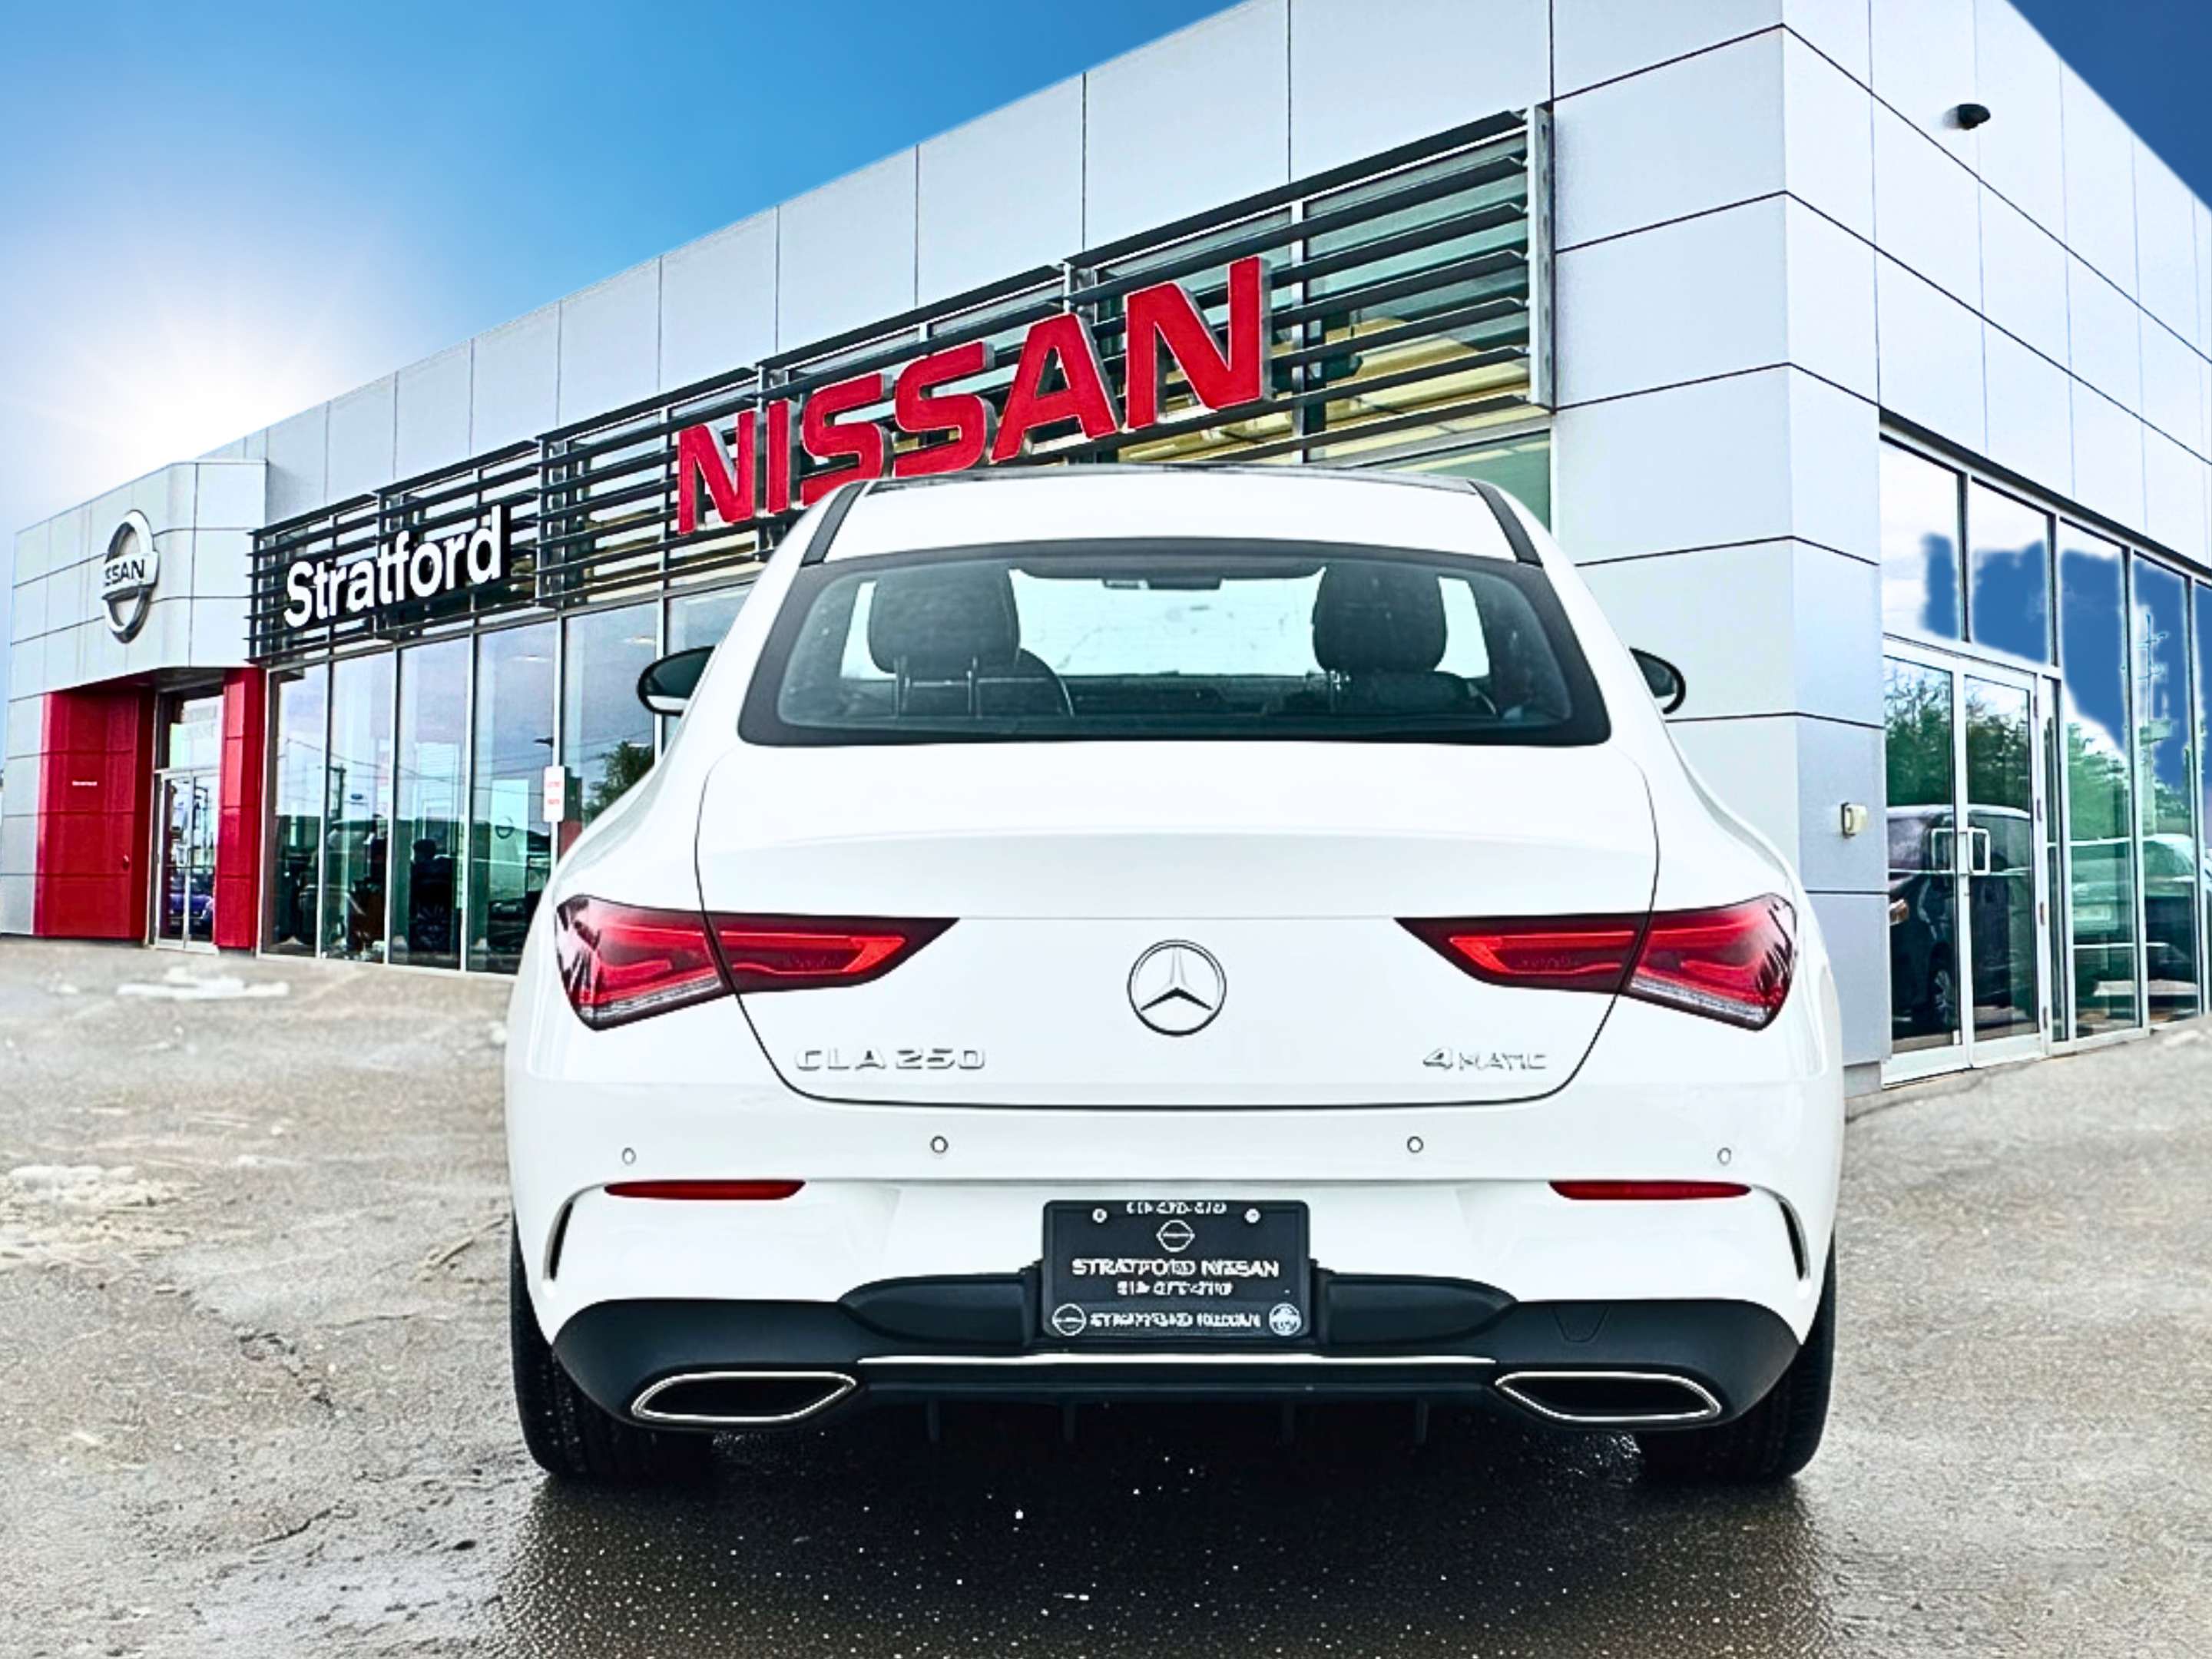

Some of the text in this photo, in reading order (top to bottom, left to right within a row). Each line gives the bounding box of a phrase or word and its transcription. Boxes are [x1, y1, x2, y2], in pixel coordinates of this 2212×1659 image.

[677, 256, 1266, 536] NISSAN
[104, 558, 145, 587] SSAN
[283, 504, 502, 628] Stratford
[796, 1048, 985, 1071] CLA 250
[1422, 1047, 1548, 1071] 4MATIC
[1071, 1258, 1280, 1277] STRATFORD NISSAN
